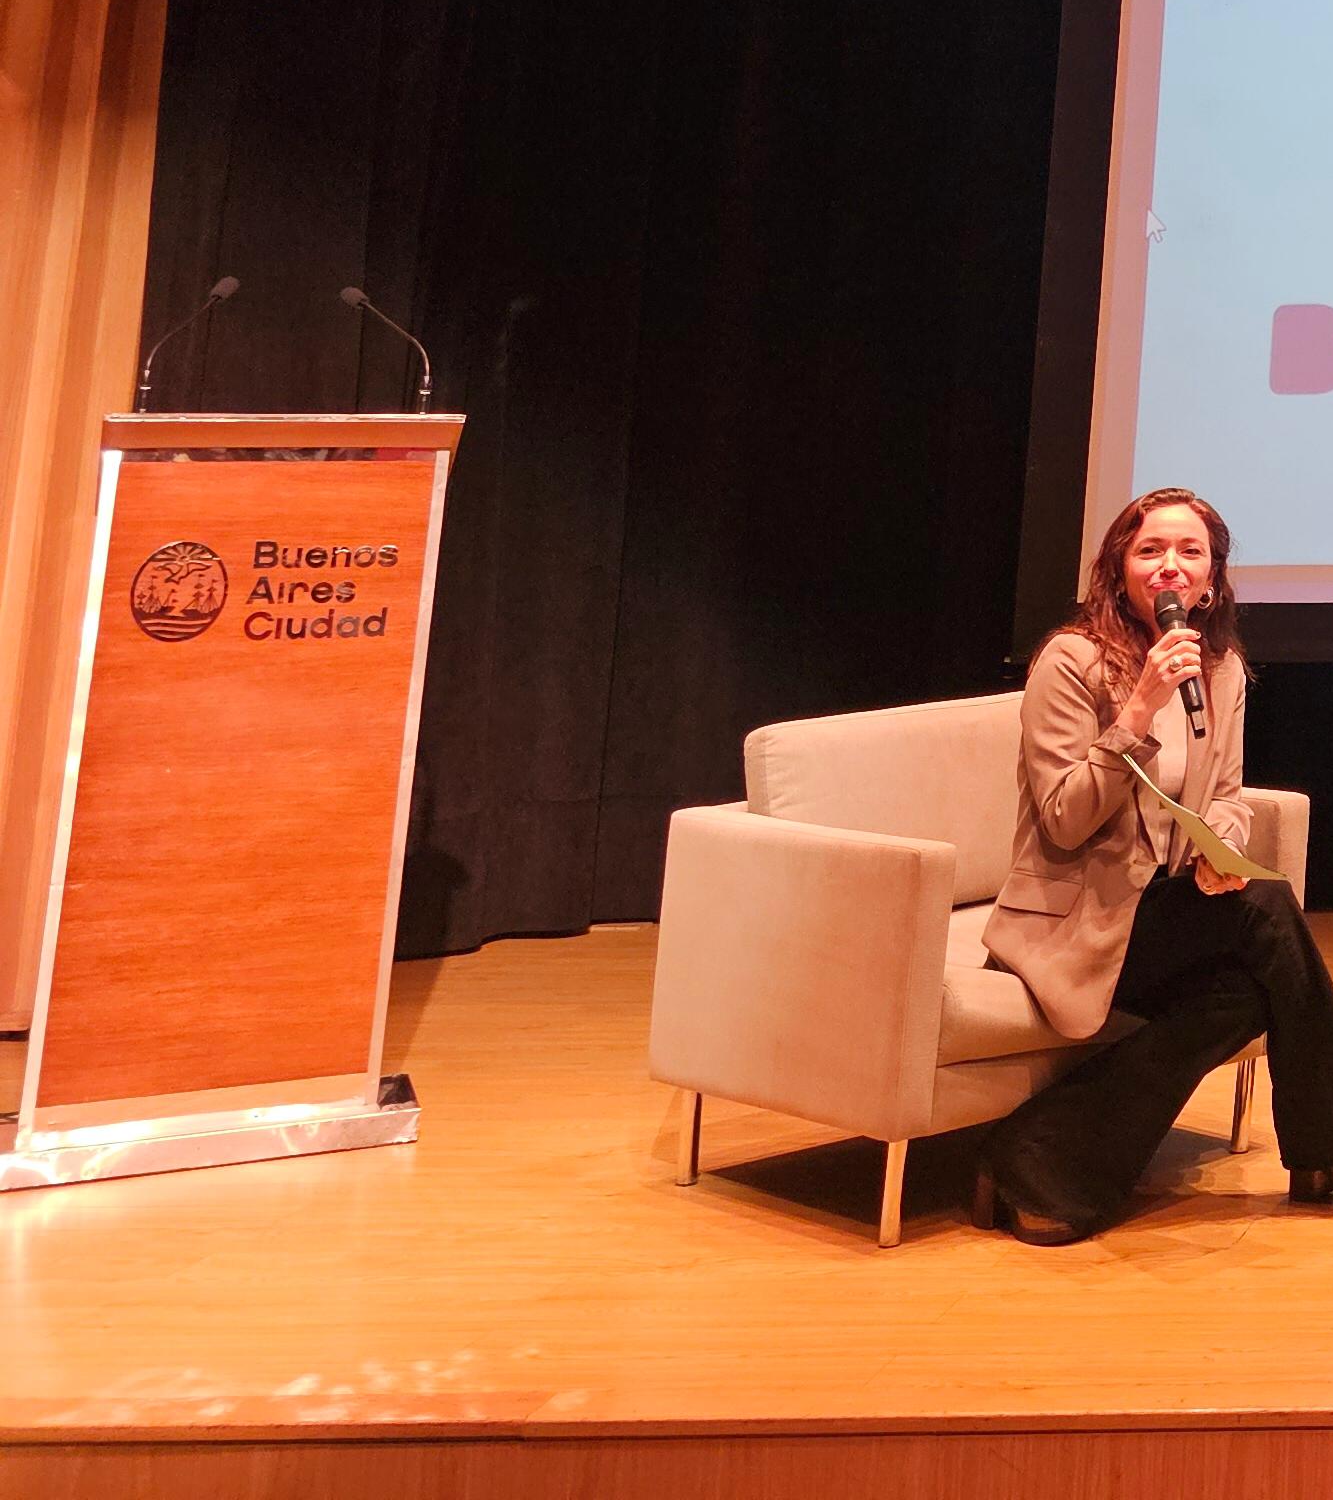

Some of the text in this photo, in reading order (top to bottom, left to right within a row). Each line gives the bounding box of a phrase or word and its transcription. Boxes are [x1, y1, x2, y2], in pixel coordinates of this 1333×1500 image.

[252, 540, 399, 570] Buenos
[245, 576, 357, 606] Aires
[243, 606, 389, 642] Ciudad
